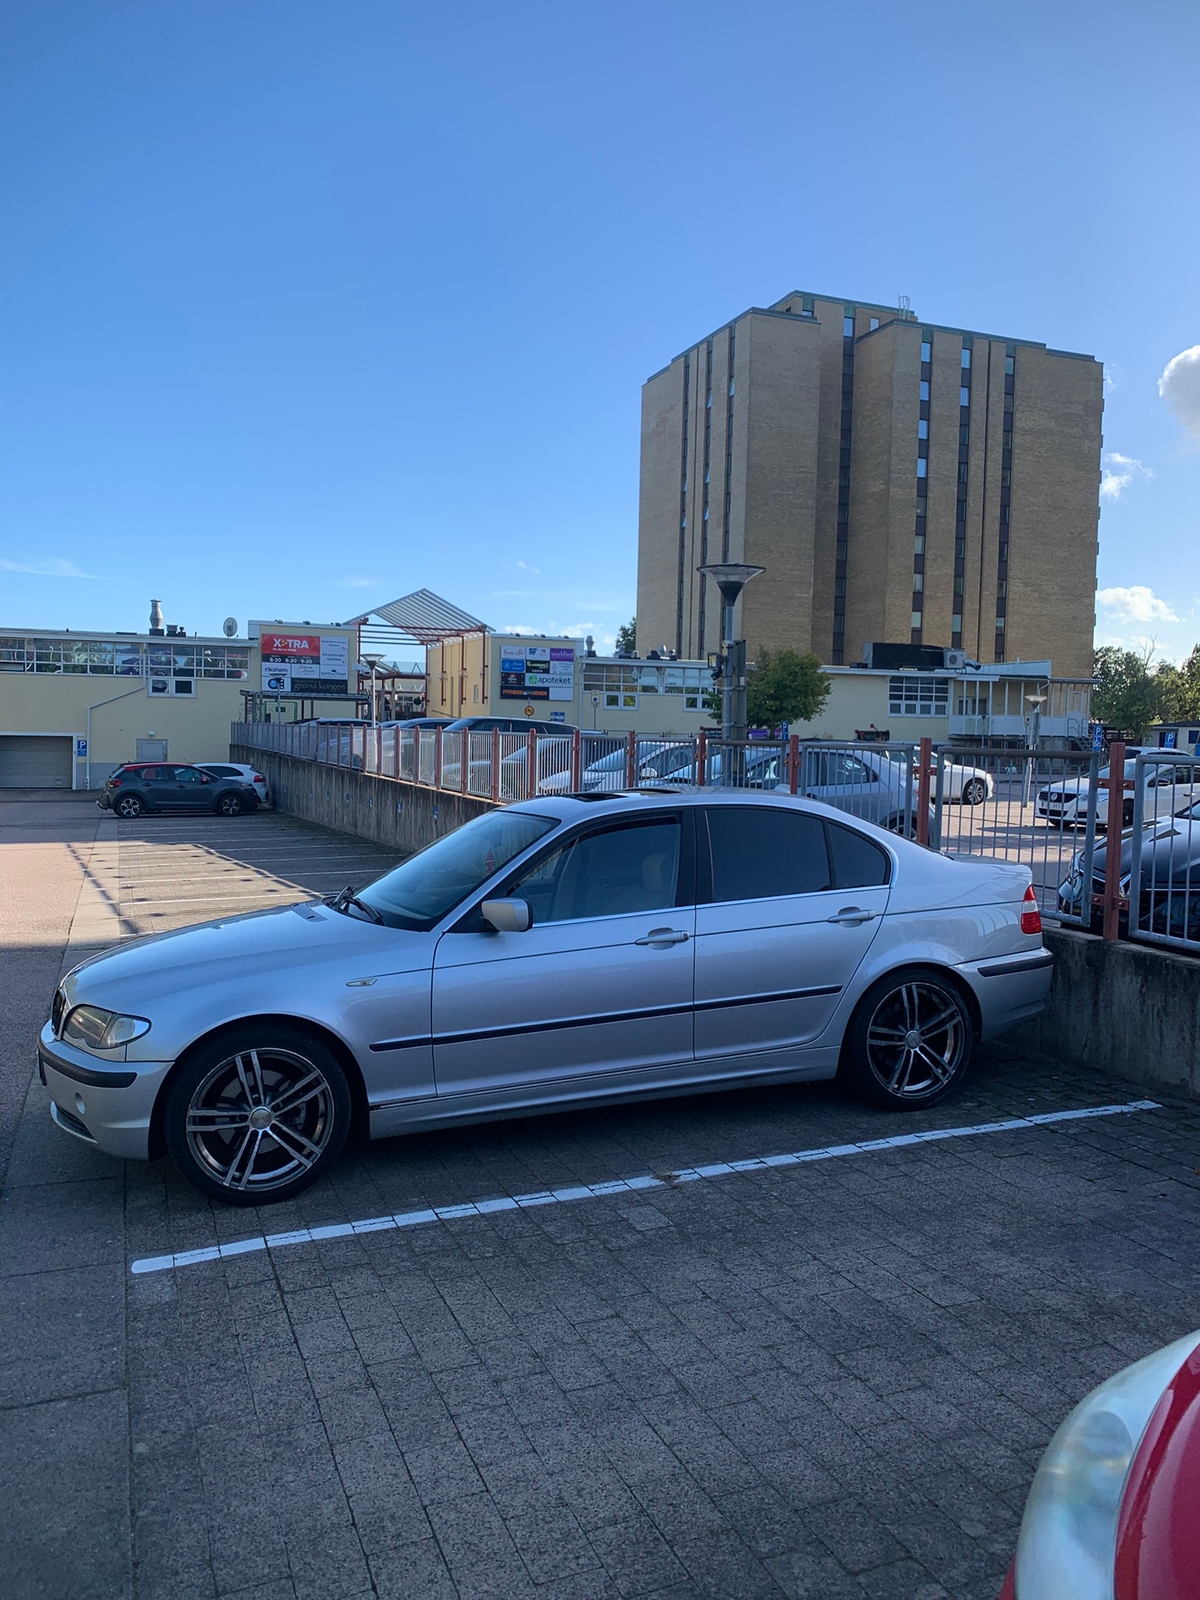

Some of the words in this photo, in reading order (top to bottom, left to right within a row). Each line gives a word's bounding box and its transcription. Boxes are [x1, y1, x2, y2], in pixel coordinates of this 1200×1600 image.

[537, 676, 571, 685] apoteket
[318, 680, 346, 692] korgen
[1167, 733, 1174, 742] P
[79, 740, 86, 749] P
